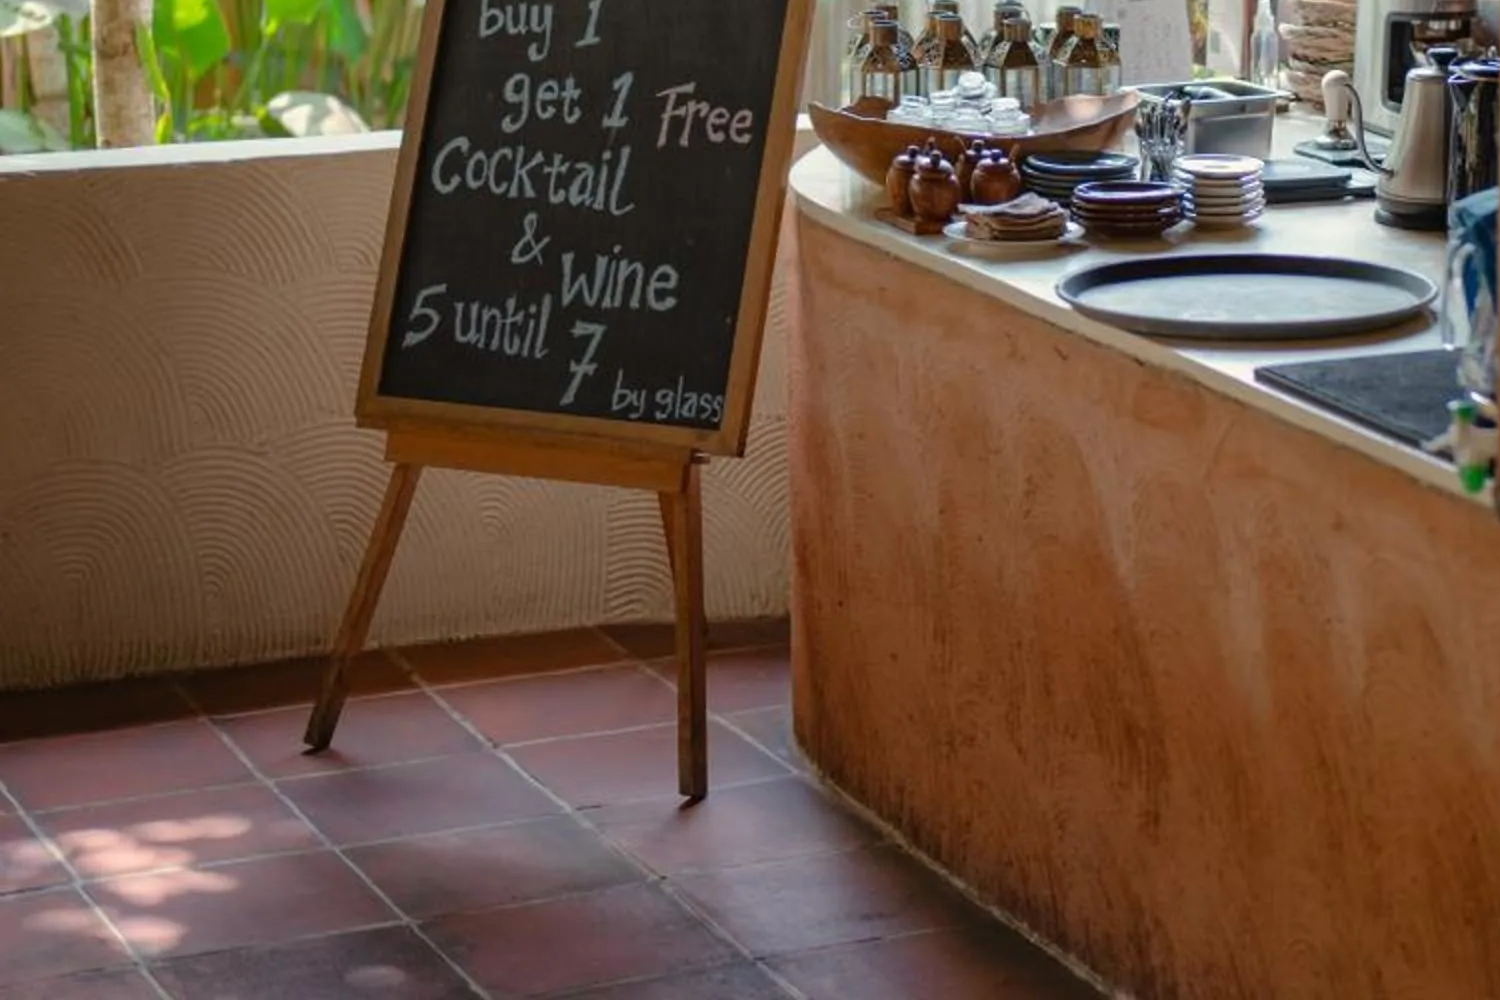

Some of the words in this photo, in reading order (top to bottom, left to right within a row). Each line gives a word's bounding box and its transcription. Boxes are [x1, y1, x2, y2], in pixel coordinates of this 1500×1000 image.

[502, 72, 582, 134] get
[603, 72, 634, 129] 1
[656, 83, 754, 149] Free
[431, 136, 635, 217] Cocktail
[511, 211, 551, 266] &
[560, 245, 679, 311] Wine
[402, 284, 447, 348] 5
[454, 294, 552, 359] until
[560, 322, 606, 406] 7
[611, 369, 647, 419] by
[654, 376, 725, 424] glass
